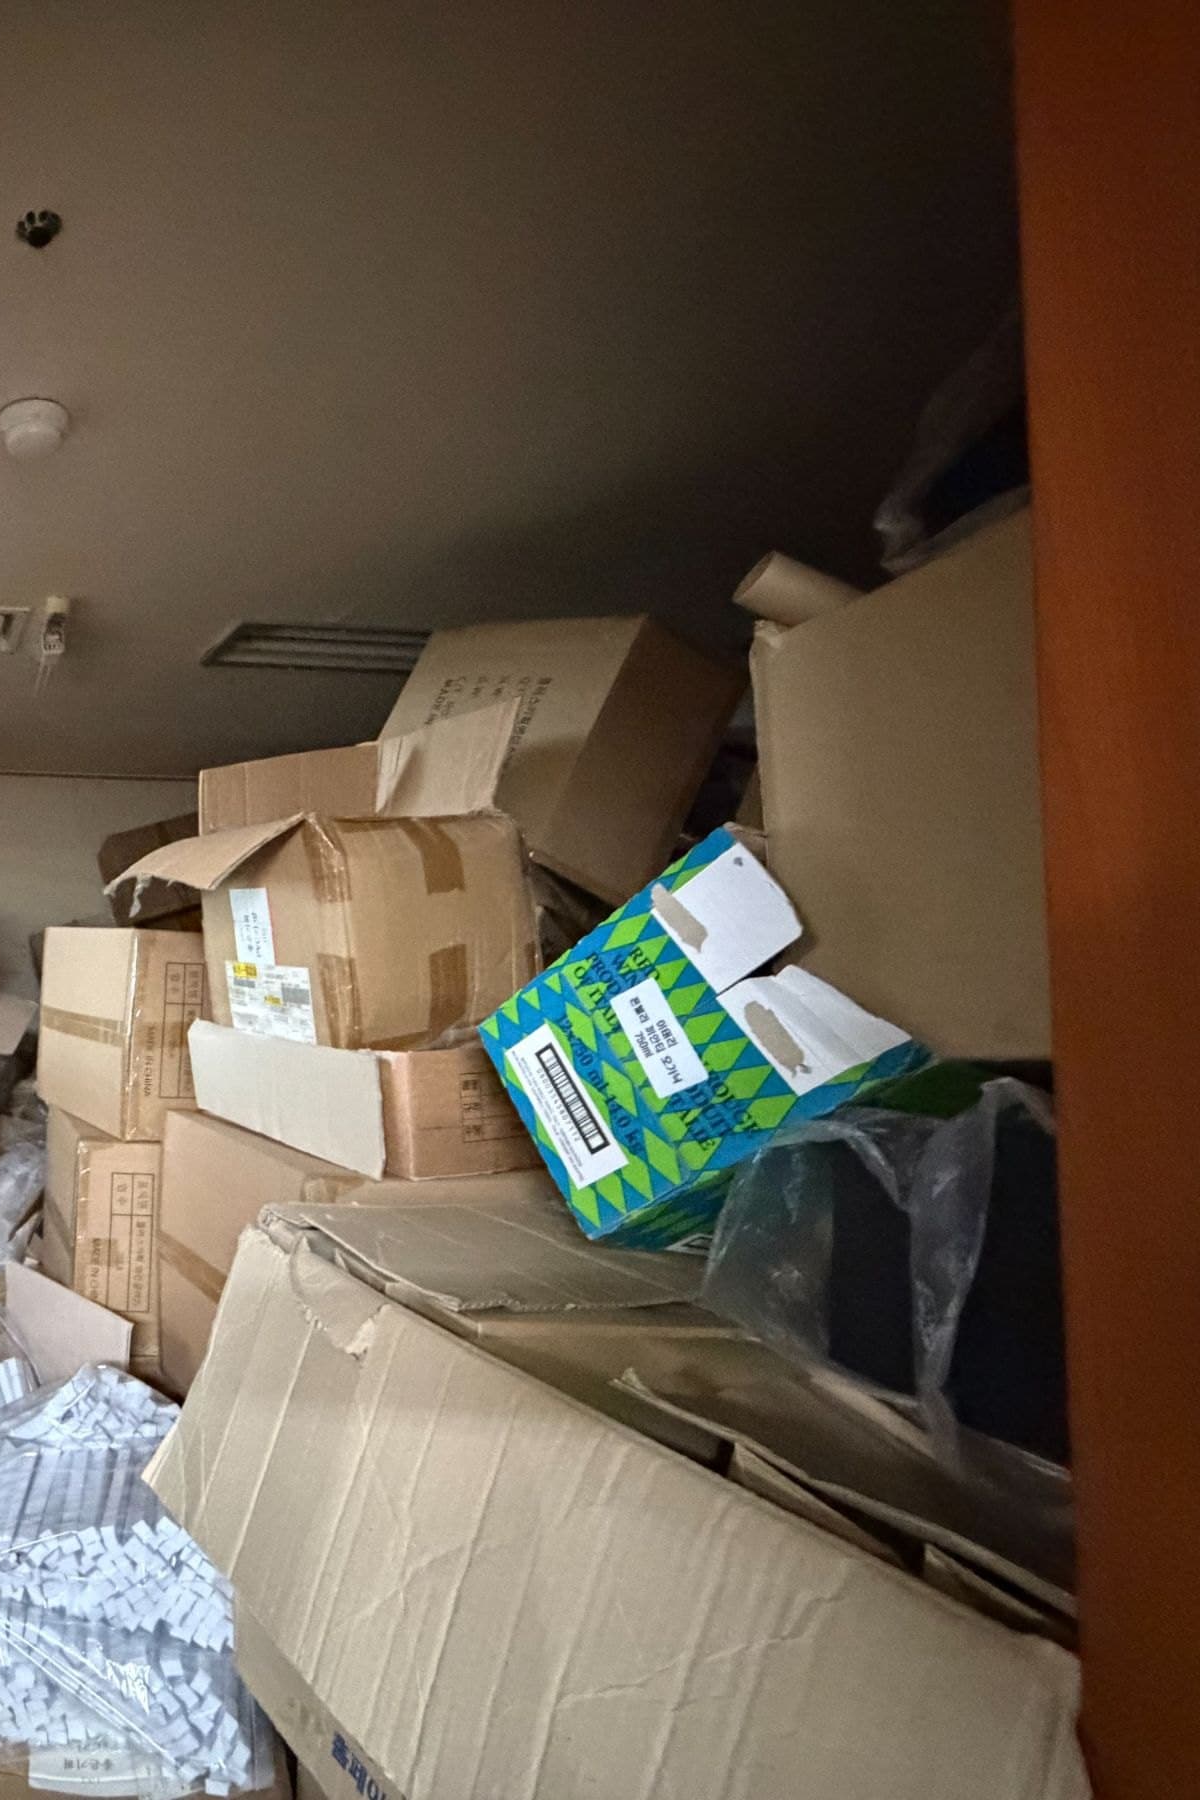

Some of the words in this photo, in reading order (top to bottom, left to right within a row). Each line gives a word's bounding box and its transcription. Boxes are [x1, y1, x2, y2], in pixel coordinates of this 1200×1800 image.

[585, 951, 622, 998] PROD
[610, 953, 639, 988] WIN
[628, 946, 661, 983] RED
[633, 1031, 654, 1058] 750ml
